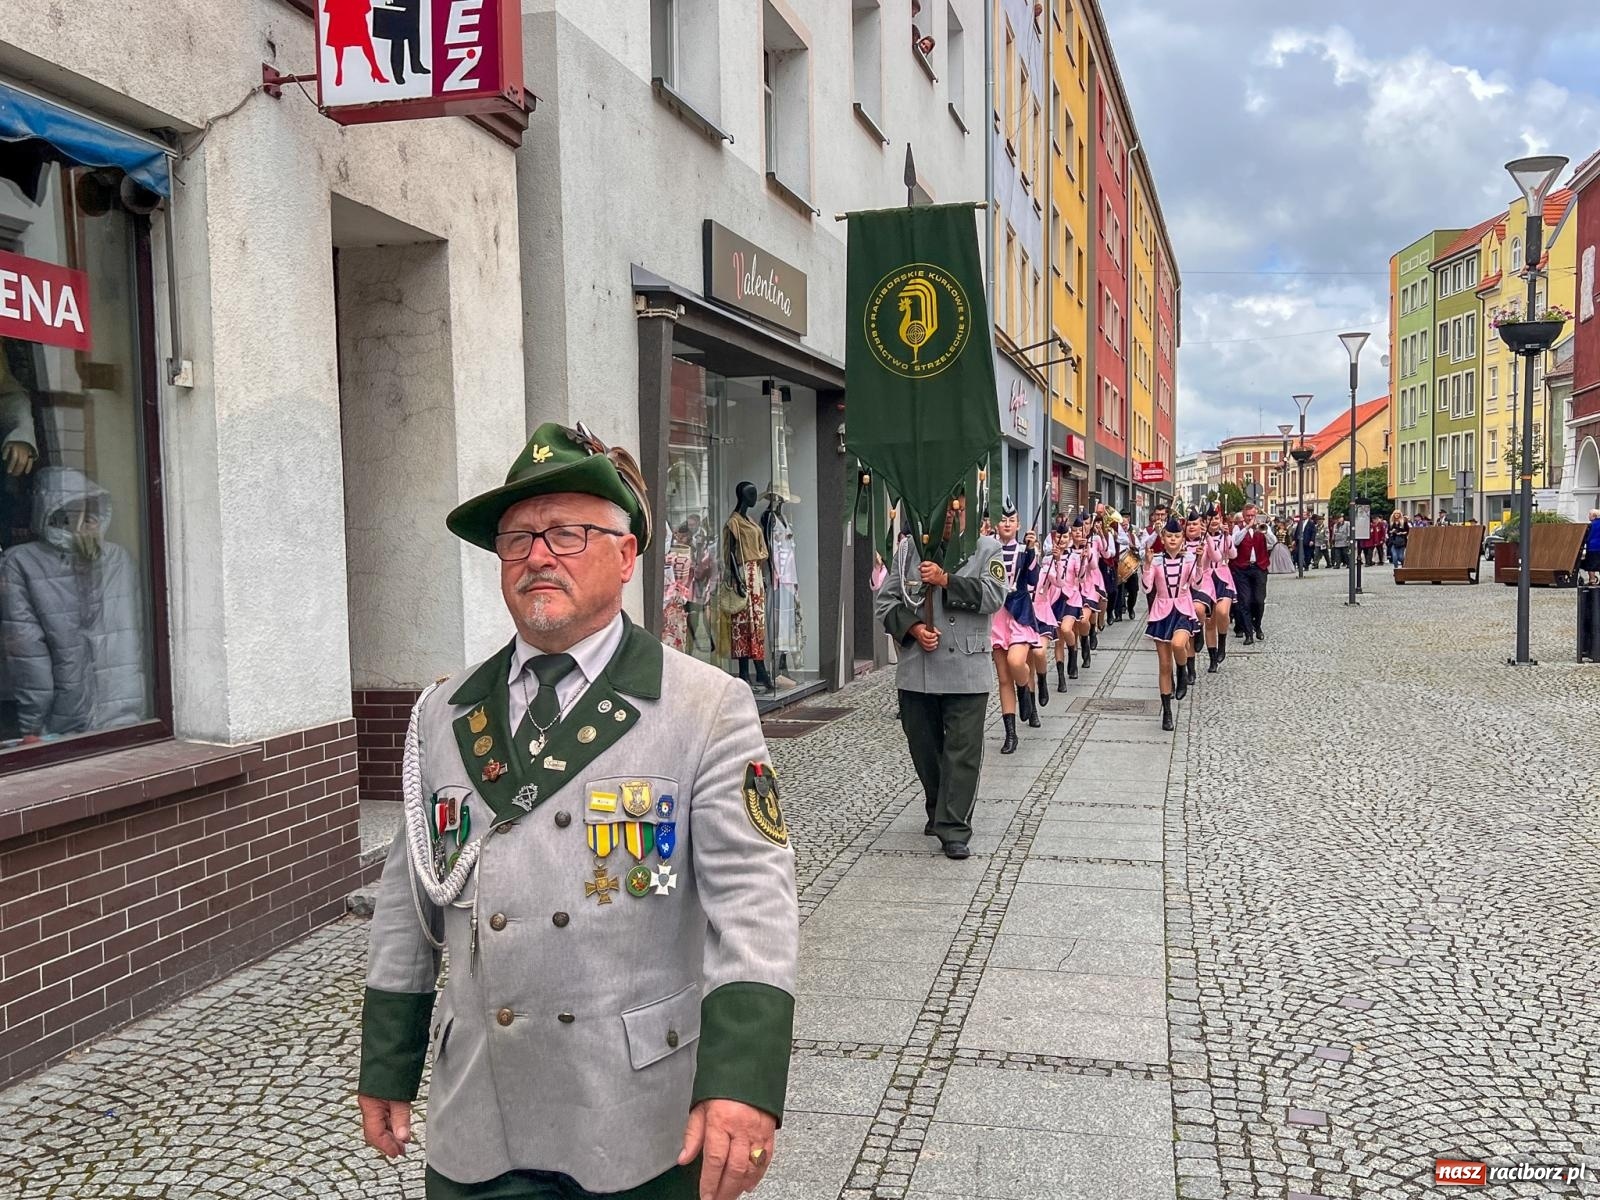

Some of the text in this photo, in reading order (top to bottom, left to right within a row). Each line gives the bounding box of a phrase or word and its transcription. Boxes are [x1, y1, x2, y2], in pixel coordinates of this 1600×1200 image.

[732, 251, 793, 317] Valentina
[870, 270, 965, 321] RACIBORSKIE KURKOWE
[871, 323, 965, 372] BRACTWO STRZELECKIE
